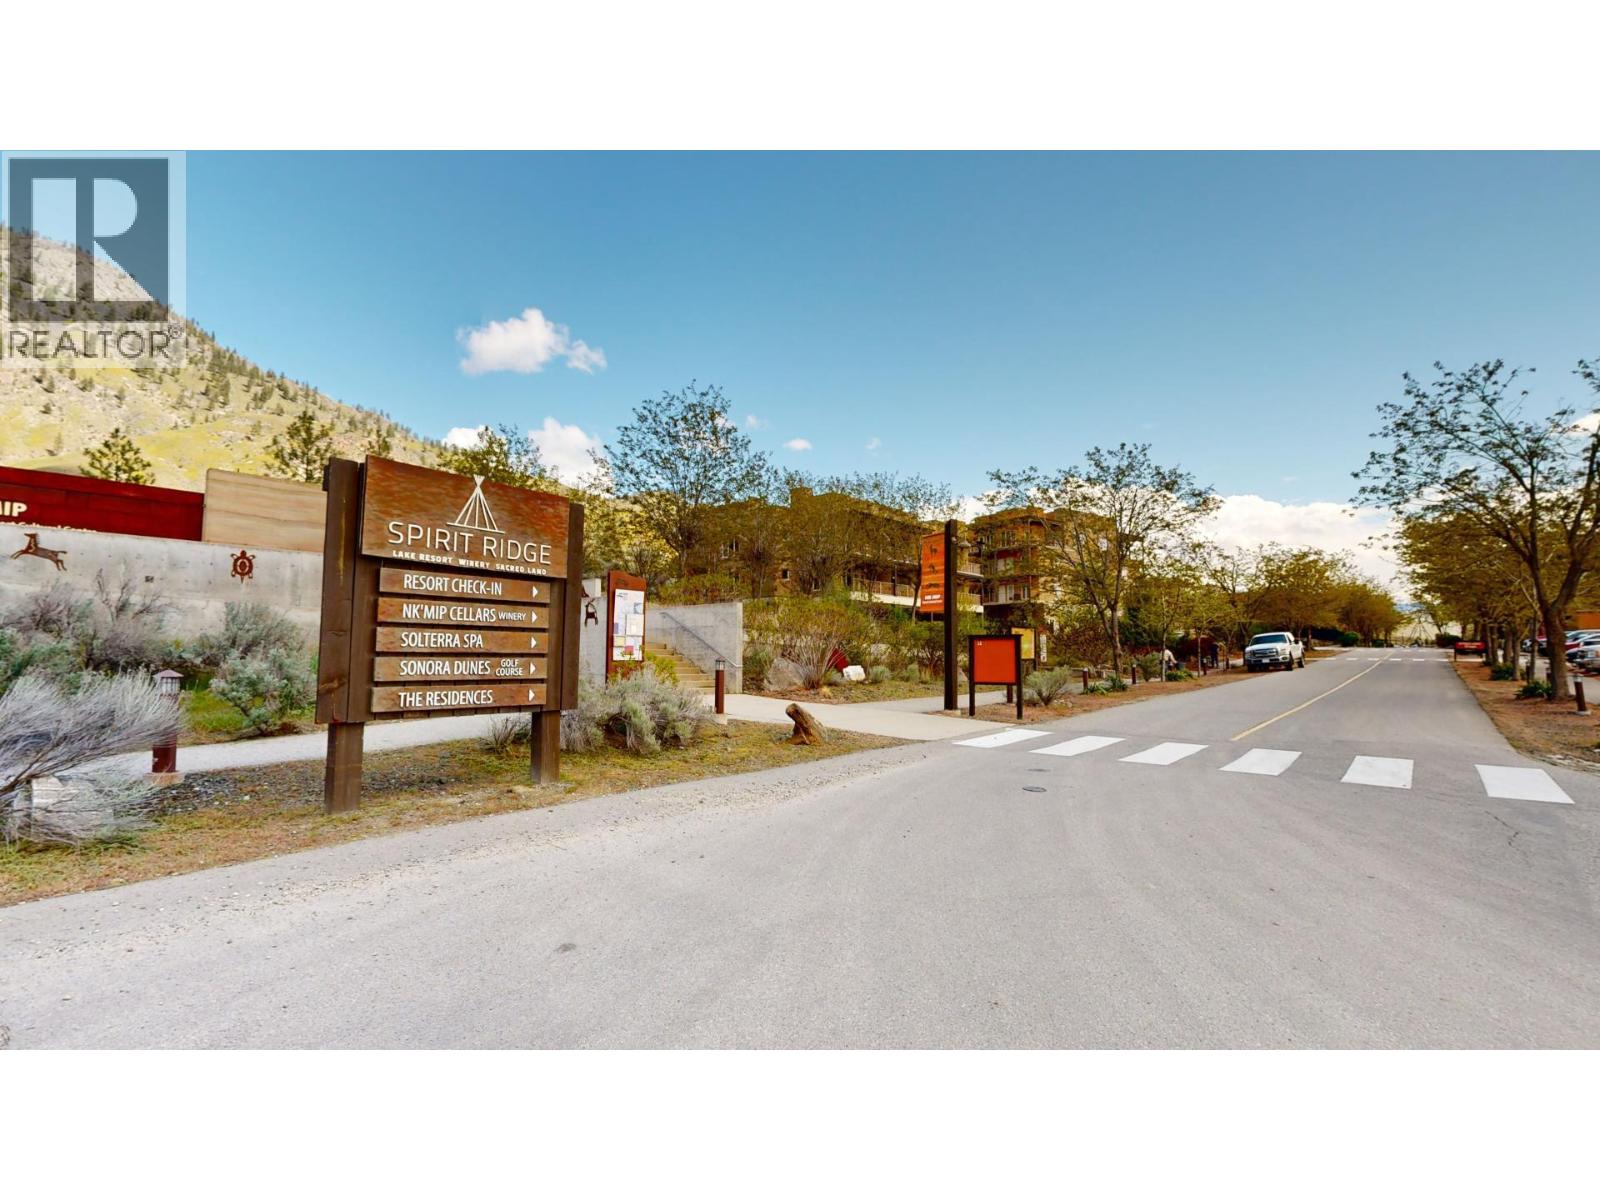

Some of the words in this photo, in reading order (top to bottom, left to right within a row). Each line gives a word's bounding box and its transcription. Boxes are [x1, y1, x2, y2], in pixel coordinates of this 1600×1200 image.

[388, 521, 474, 553] SPIRIT
[483, 536, 552, 565] RIDGE
[392, 550, 416, 560] LAKE
[419, 553, 453, 564] RESORT
[458, 558, 490, 569] WINERY
[495, 563, 525, 574] SACRED
[527, 567, 547, 576] LAND
[403, 574, 450, 591] RESORT
[451, 578, 502, 595] CHECK-IN
[402, 603, 447, 620] NK'MIP
[449, 606, 496, 622] CELLARS
[498, 611, 526, 621] WINERY
[400, 631, 461, 648] SOLTERRA
[463, 633, 484, 648] SPA
[400, 660, 451, 675] SONORA
[453, 660, 491, 675] DUNES
[495, 667, 523, 676] COURSE
[500, 658, 519, 667] GOLF
[398, 692, 423, 707] THE
[425, 689, 494, 706] RESIDENCES
